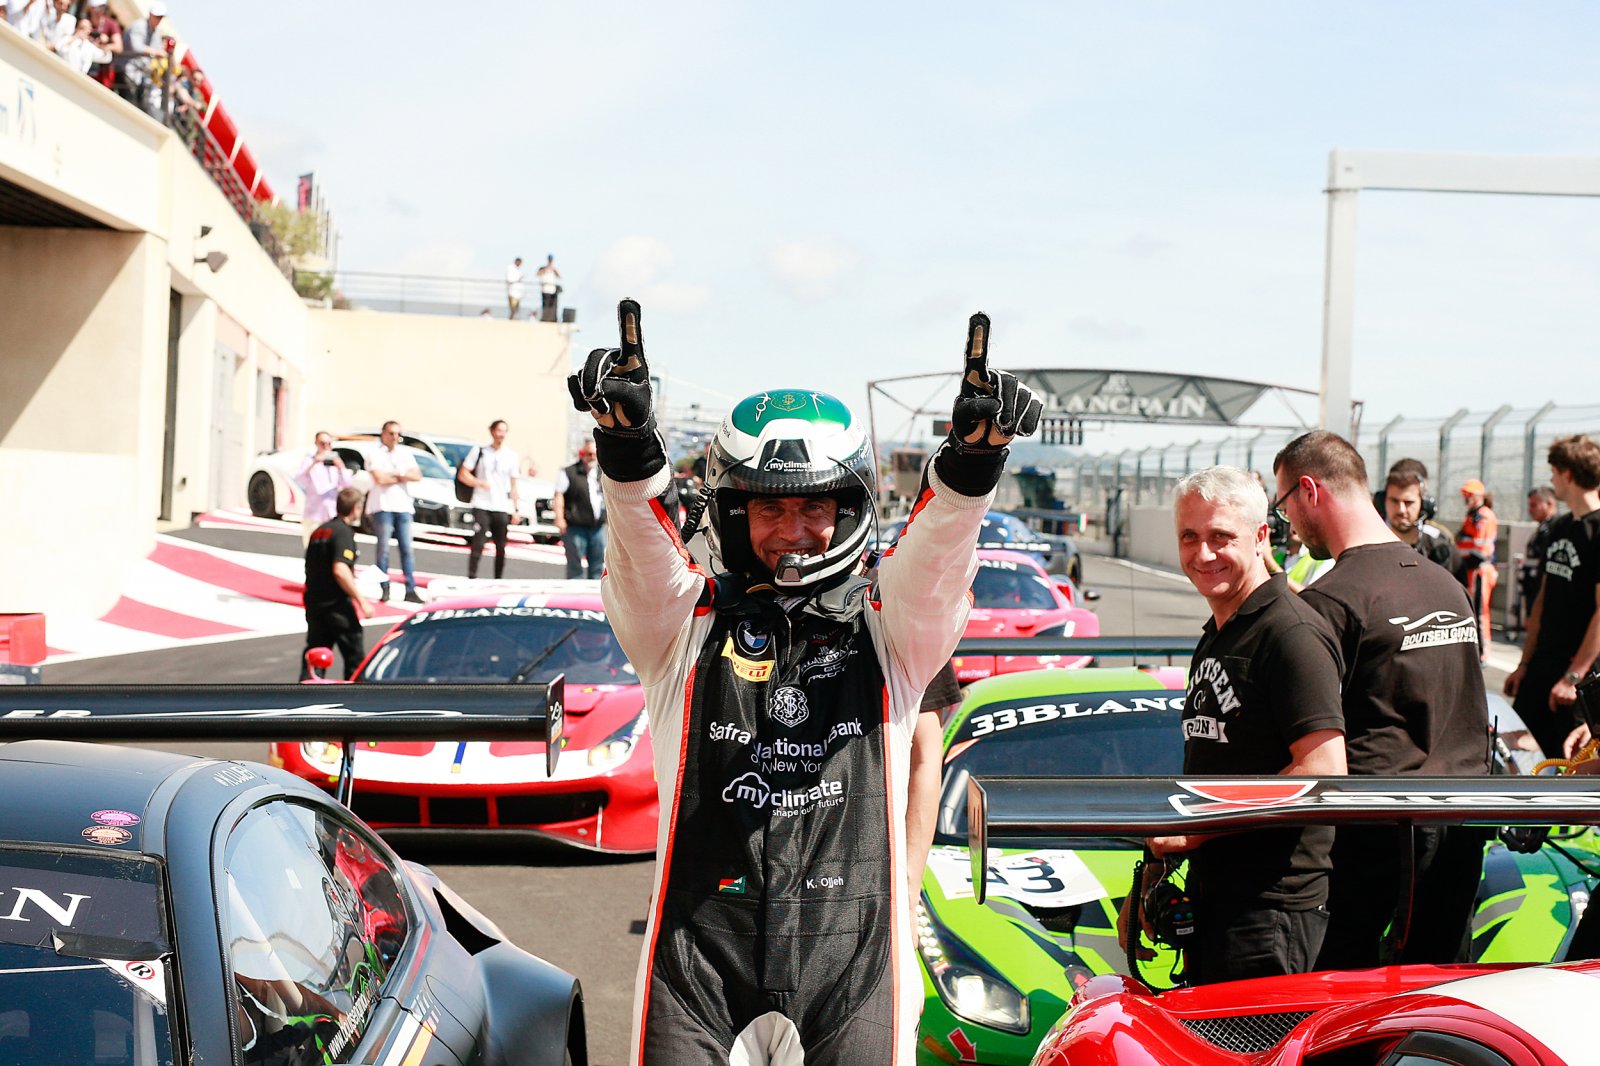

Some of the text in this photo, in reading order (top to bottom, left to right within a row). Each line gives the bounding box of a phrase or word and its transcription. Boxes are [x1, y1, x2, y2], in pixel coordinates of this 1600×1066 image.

[769, 461, 814, 470] myclimat
[979, 560, 1018, 571] AIN
[1403, 628, 1450, 647] BOUTSEN
[709, 721, 752, 746] Safra
[800, 759, 823, 774] Yor
[736, 779, 843, 809] myclimate
[772, 796, 845, 819] shape our future
[806, 878, 818, 890] K.
